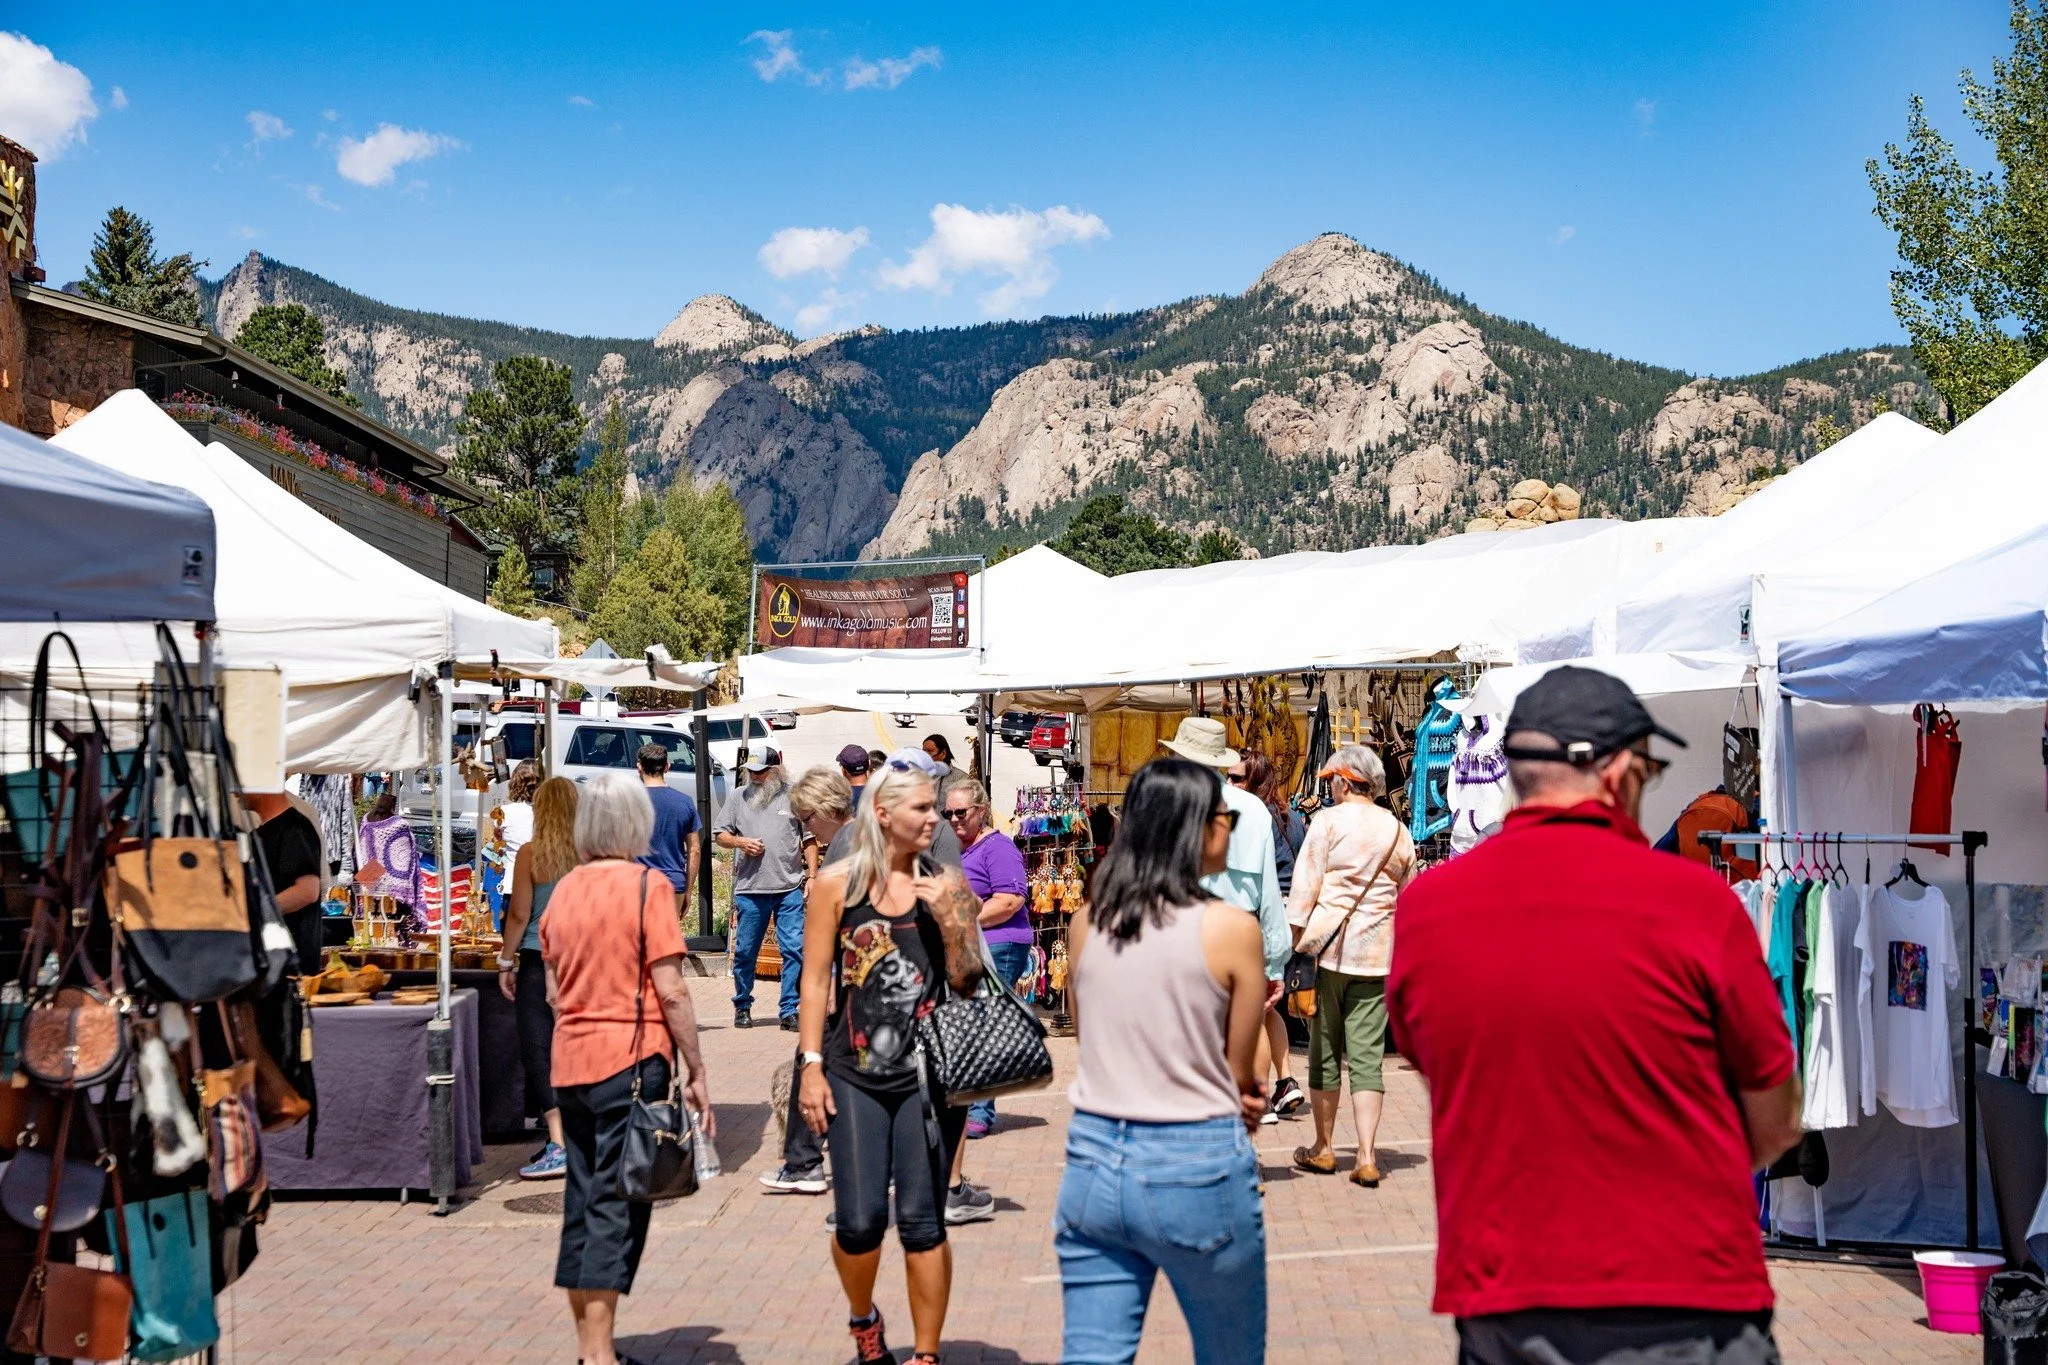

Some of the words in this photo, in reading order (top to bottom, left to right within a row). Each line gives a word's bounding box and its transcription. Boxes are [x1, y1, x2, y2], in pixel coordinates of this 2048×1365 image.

[831, 591, 852, 600] MUSIC
[852, 591, 868, 600] FOR
[867, 590, 889, 600] YOUR
[783, 615, 796, 623] GOLD
[801, 607, 927, 637] www.inkagoldmusic.com
